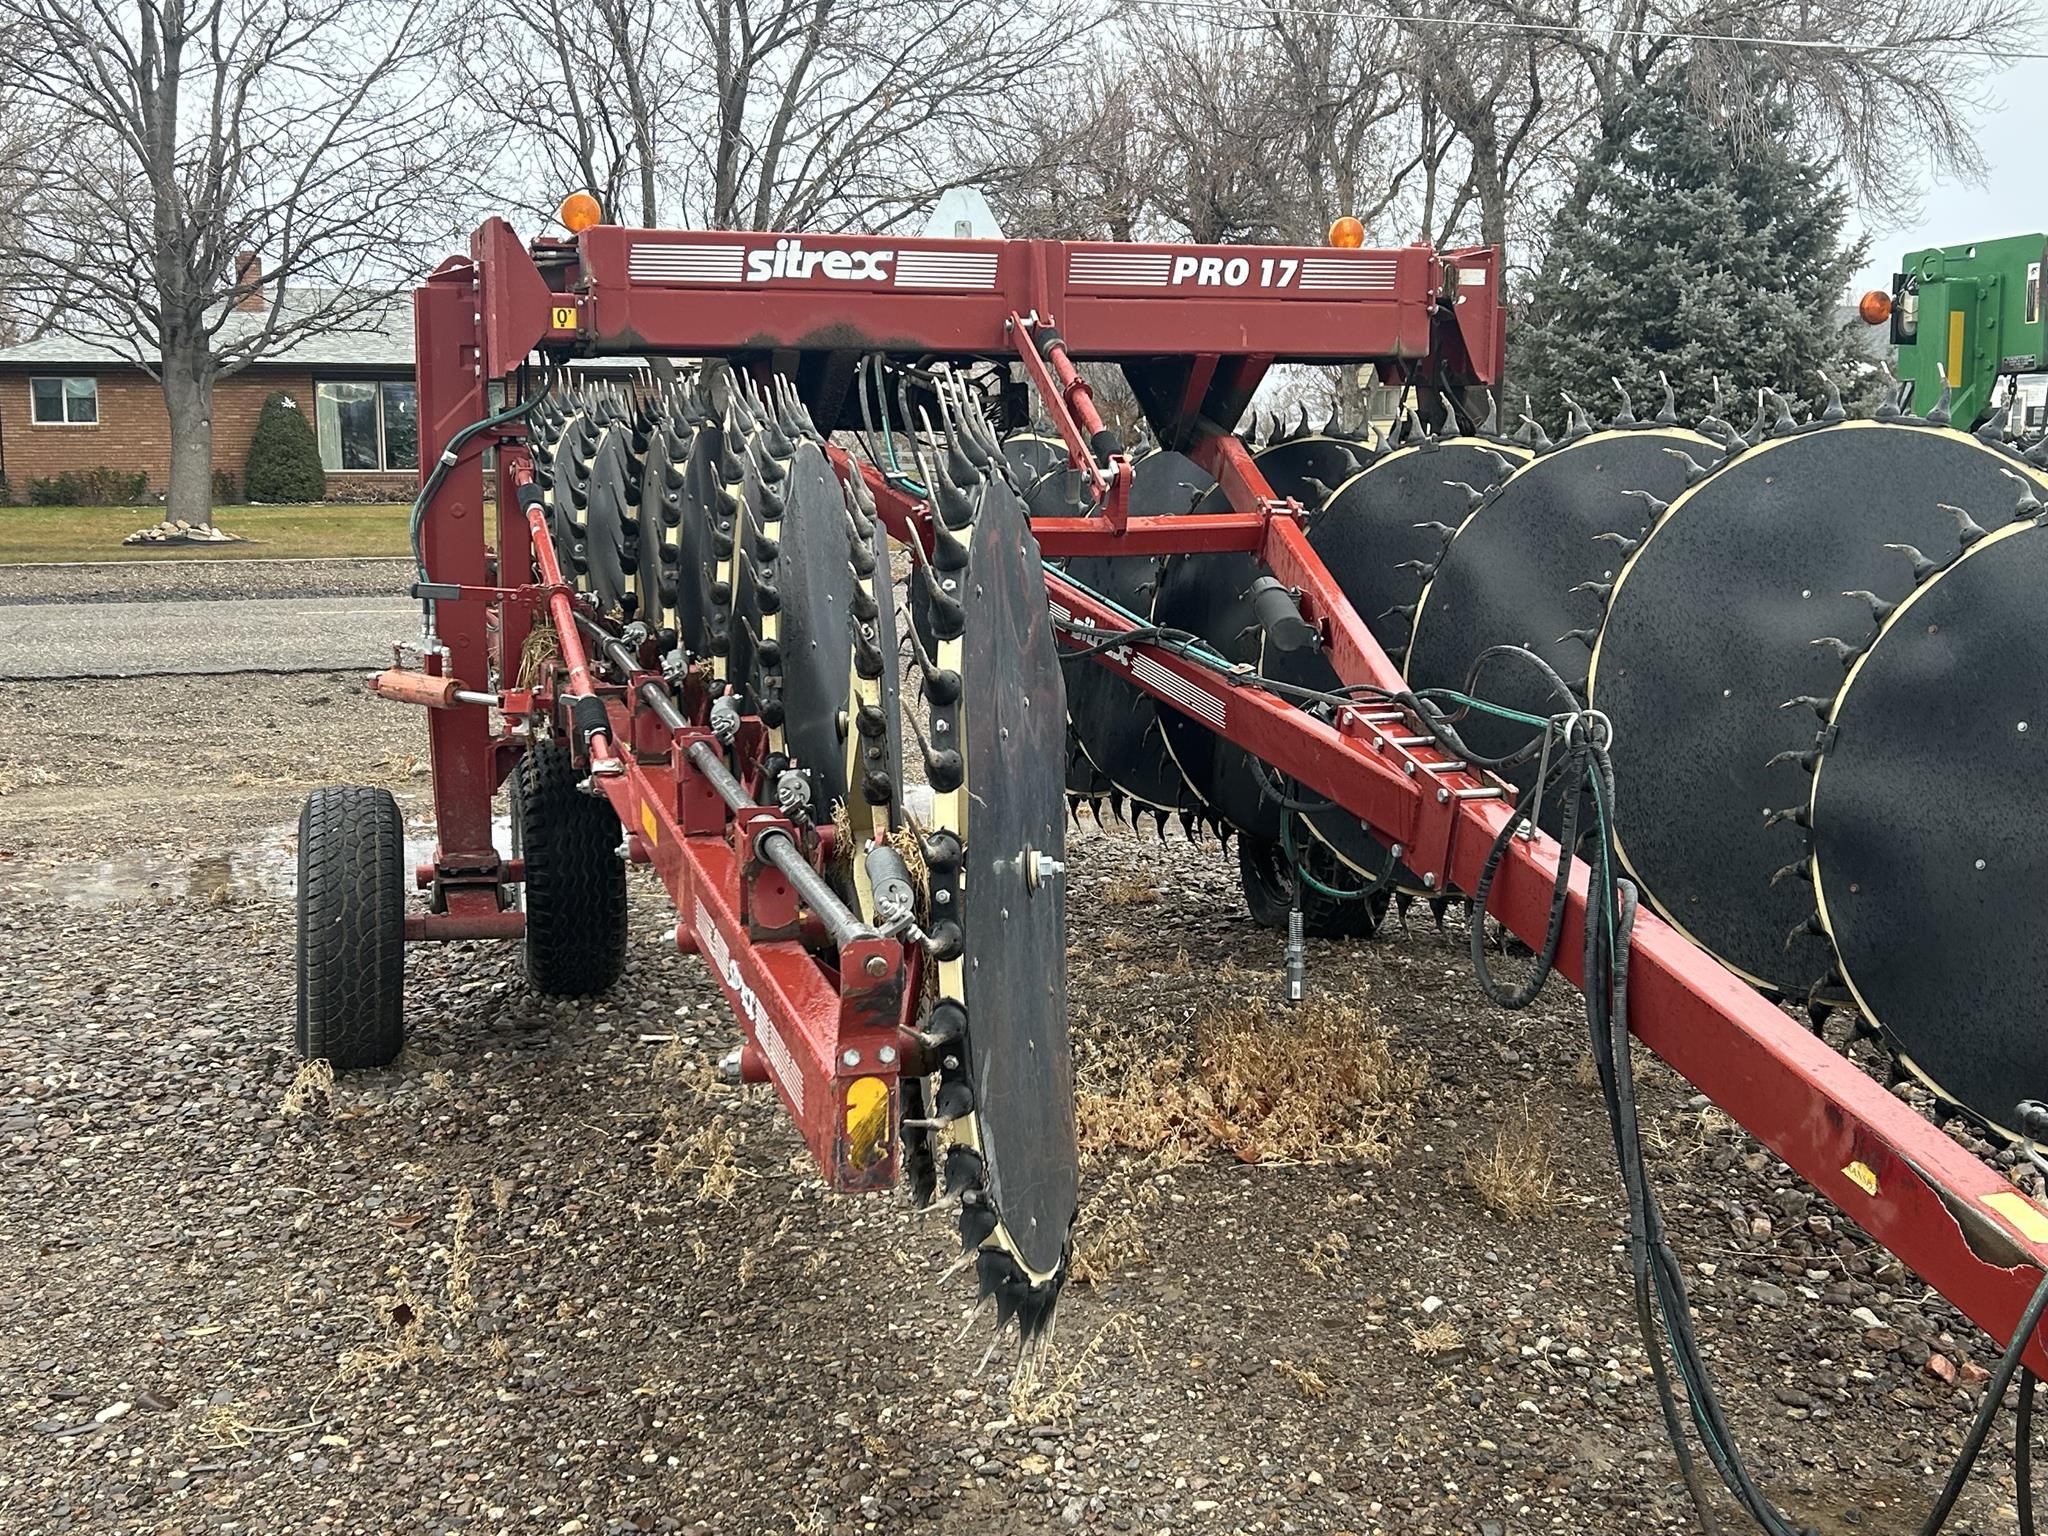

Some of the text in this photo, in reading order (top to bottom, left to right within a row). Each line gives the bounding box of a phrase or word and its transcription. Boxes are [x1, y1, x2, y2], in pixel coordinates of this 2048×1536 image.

[747, 238, 894, 281] sitrex
[1172, 256, 1299, 288] PRO 17
